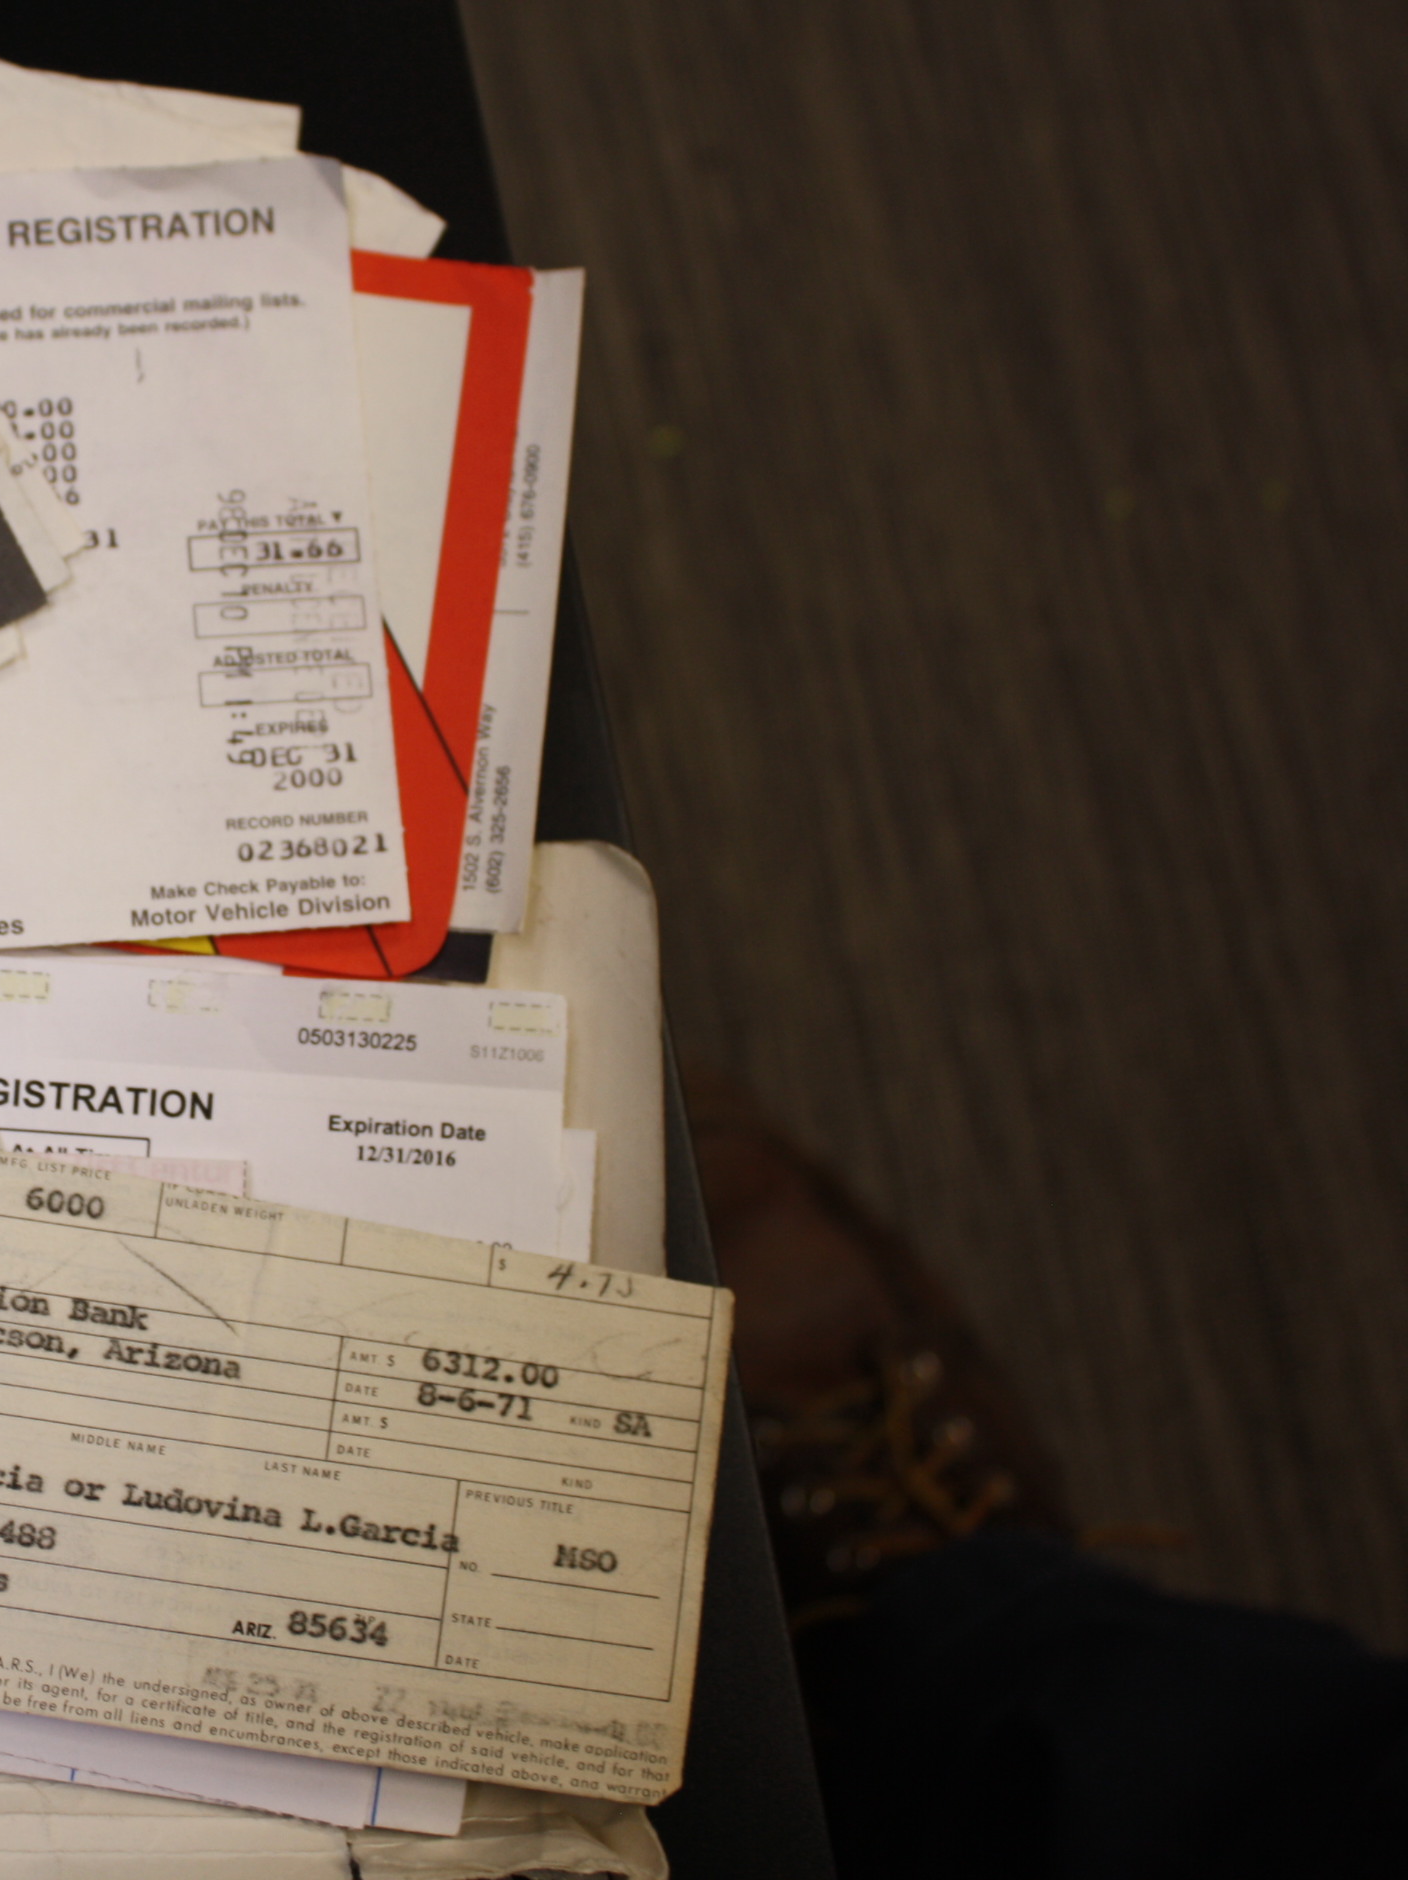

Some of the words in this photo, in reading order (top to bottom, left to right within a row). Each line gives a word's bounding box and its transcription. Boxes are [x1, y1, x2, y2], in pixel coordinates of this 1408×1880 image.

[7, 206, 275, 247] REGISTRATION
[325, 741, 357, 764] 31
[273, 767, 343, 790] 2000
[225, 814, 294, 830] RECORD
[299, 810, 368, 826] NUMBER
[237, 832, 388, 862] 02368021
[150, 884, 197, 899] Make
[203, 879, 259, 896] Check
[265, 875, 336, 895] Payable
[460, 851, 480, 892] 1502
[483, 849, 505, 894] (602)
[130, 907, 196, 927] Motor
[204, 900, 289, 921] Vehicle
[297, 894, 390, 916] Division
[297, 1027, 417, 1051] 0503130225
[327, 1114, 433, 1138] Expiration
[439, 1121, 486, 1141] Date
[36, 1160, 68, 1175] LIST
[73, 1165, 113, 1181] PRICE
[357, 1145, 456, 1167] 12/31/2016
[24, 1186, 105, 1220] 6000
[66, 1296, 151, 1331] Bank
[102, 1338, 243, 1380] Arizona
[420, 1347, 561, 1392] 6312.00
[344, 1381, 379, 1397] DATE
[415, 1382, 536, 1422] 8-6-71
[612, 1410, 655, 1439] SA
[62, 1475, 107, 1502] or
[121, 1480, 285, 1529] Ludovina
[299, 1503, 463, 1557] L.Garcia
[465, 1488, 537, 1509] PREVIOUS
[539, 1498, 574, 1515] TITLE
[553, 1542, 619, 1575] MSO
[231, 1619, 278, 1642] ARIZ.
[285, 1607, 391, 1649] 85634
[450, 1612, 492, 1630] STATE
[138, 1694, 217, 1721] certificate
[352, 1723, 445, 1755] registration
